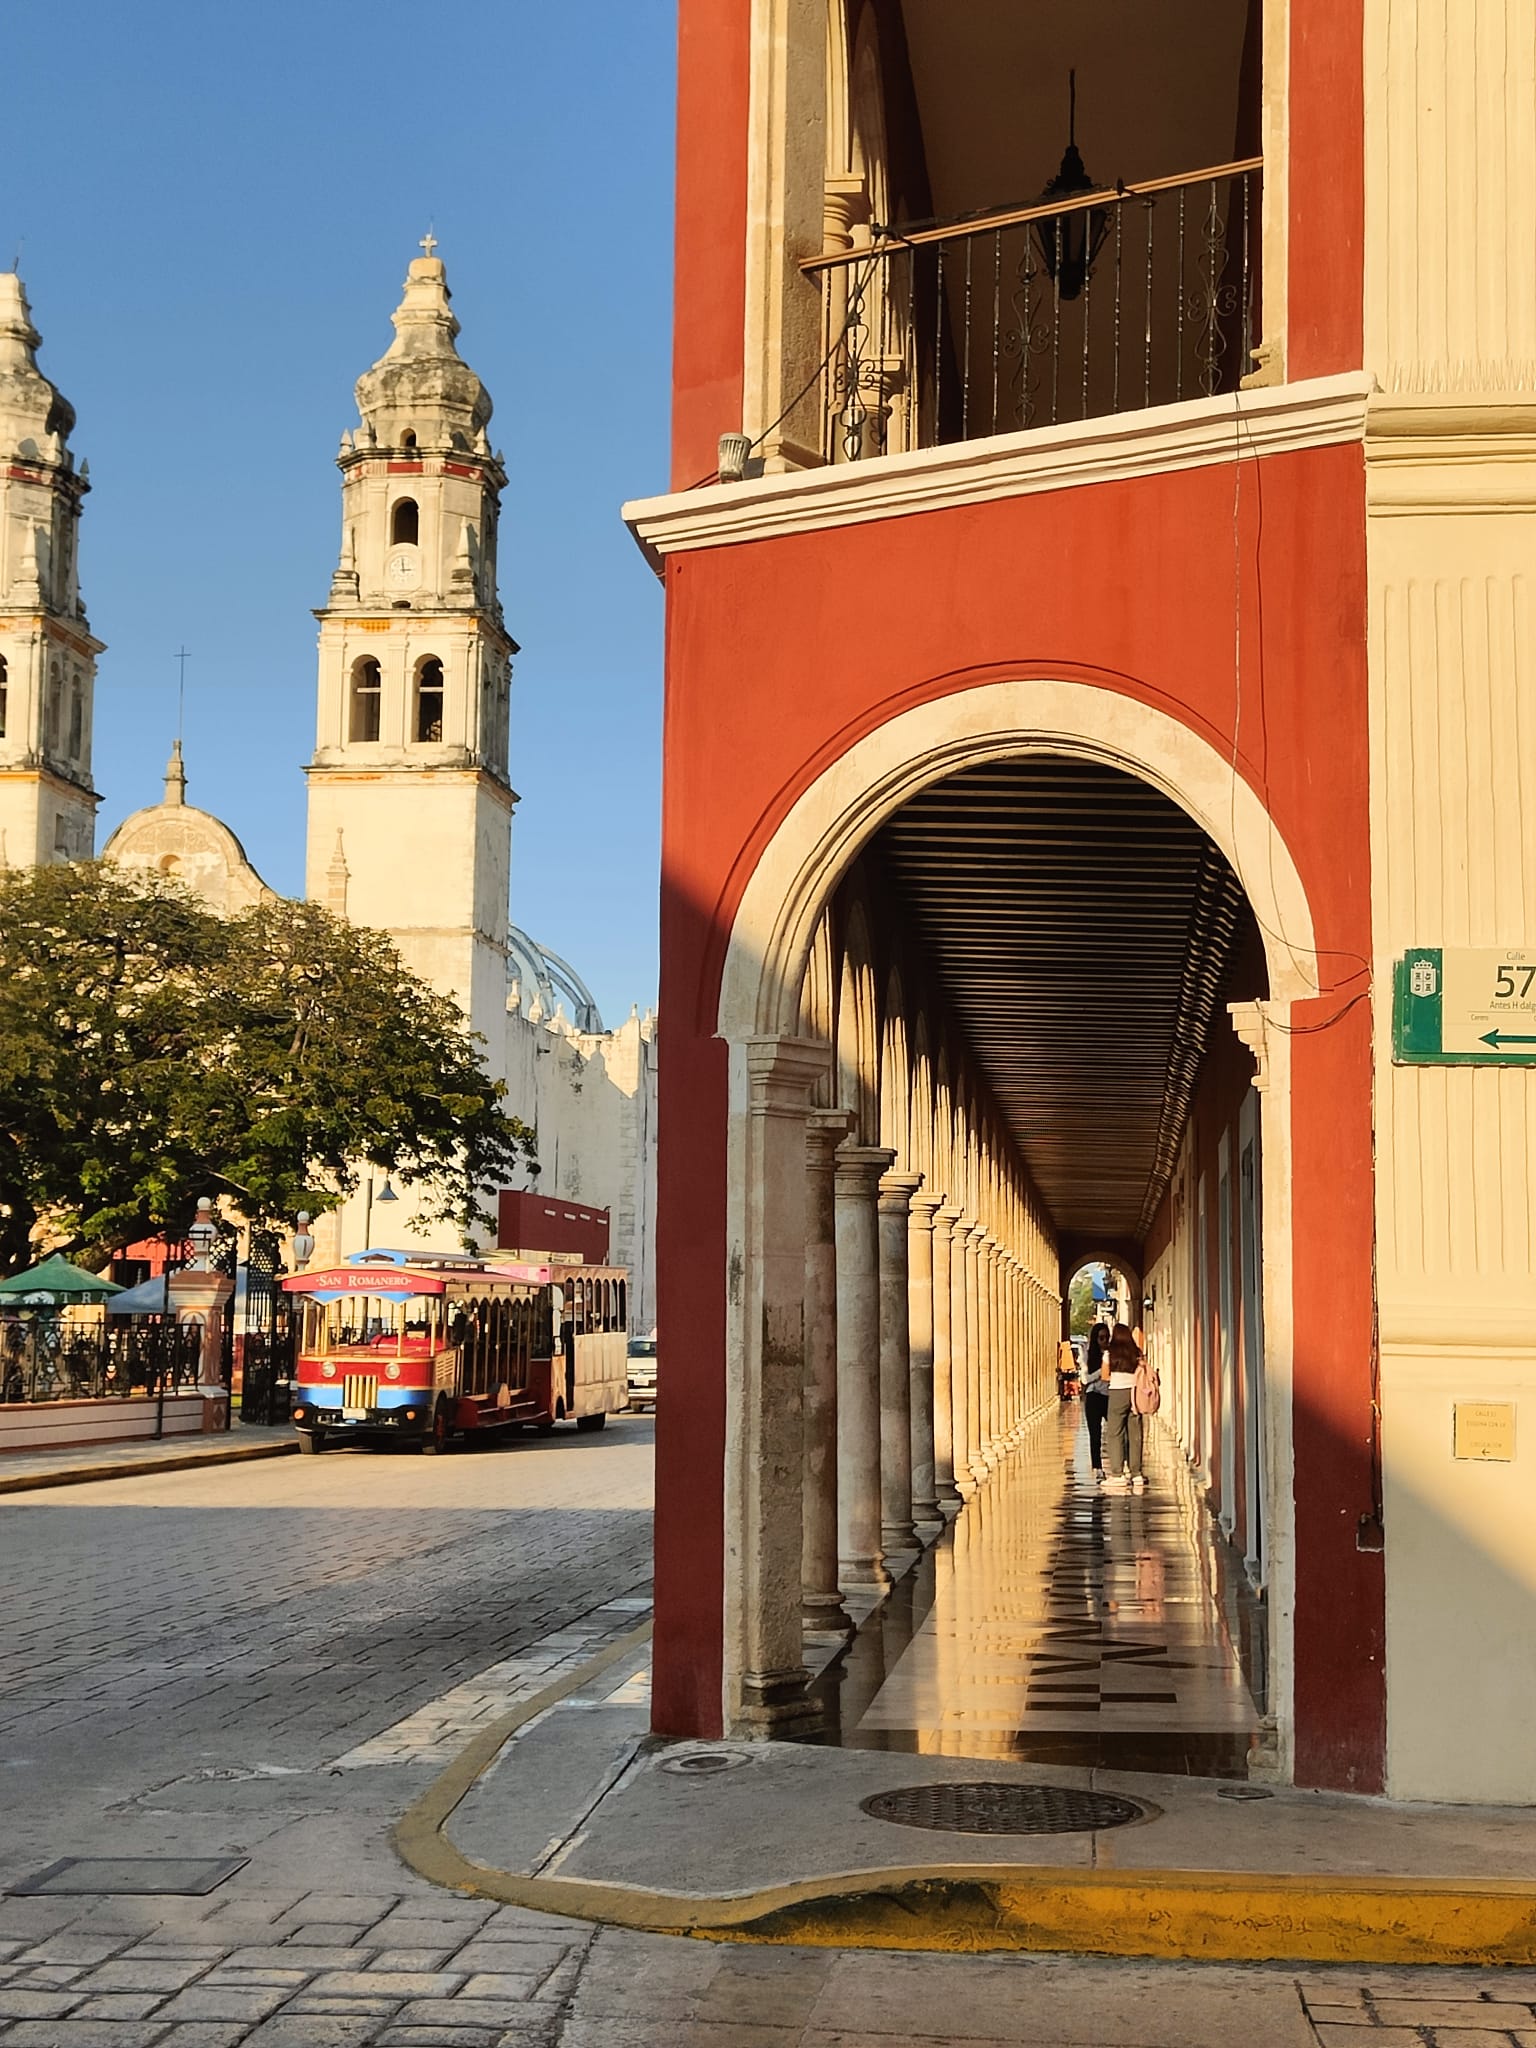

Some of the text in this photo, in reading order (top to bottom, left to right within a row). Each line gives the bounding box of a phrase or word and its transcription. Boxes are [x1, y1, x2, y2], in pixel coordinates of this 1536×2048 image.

[1506, 951, 1526, 961] Calle
[1494, 965, 1536, 998] 57
[1489, 1001, 1511, 1010] Antes
[318, 1275, 409, 1287] SAN ROMANERO
